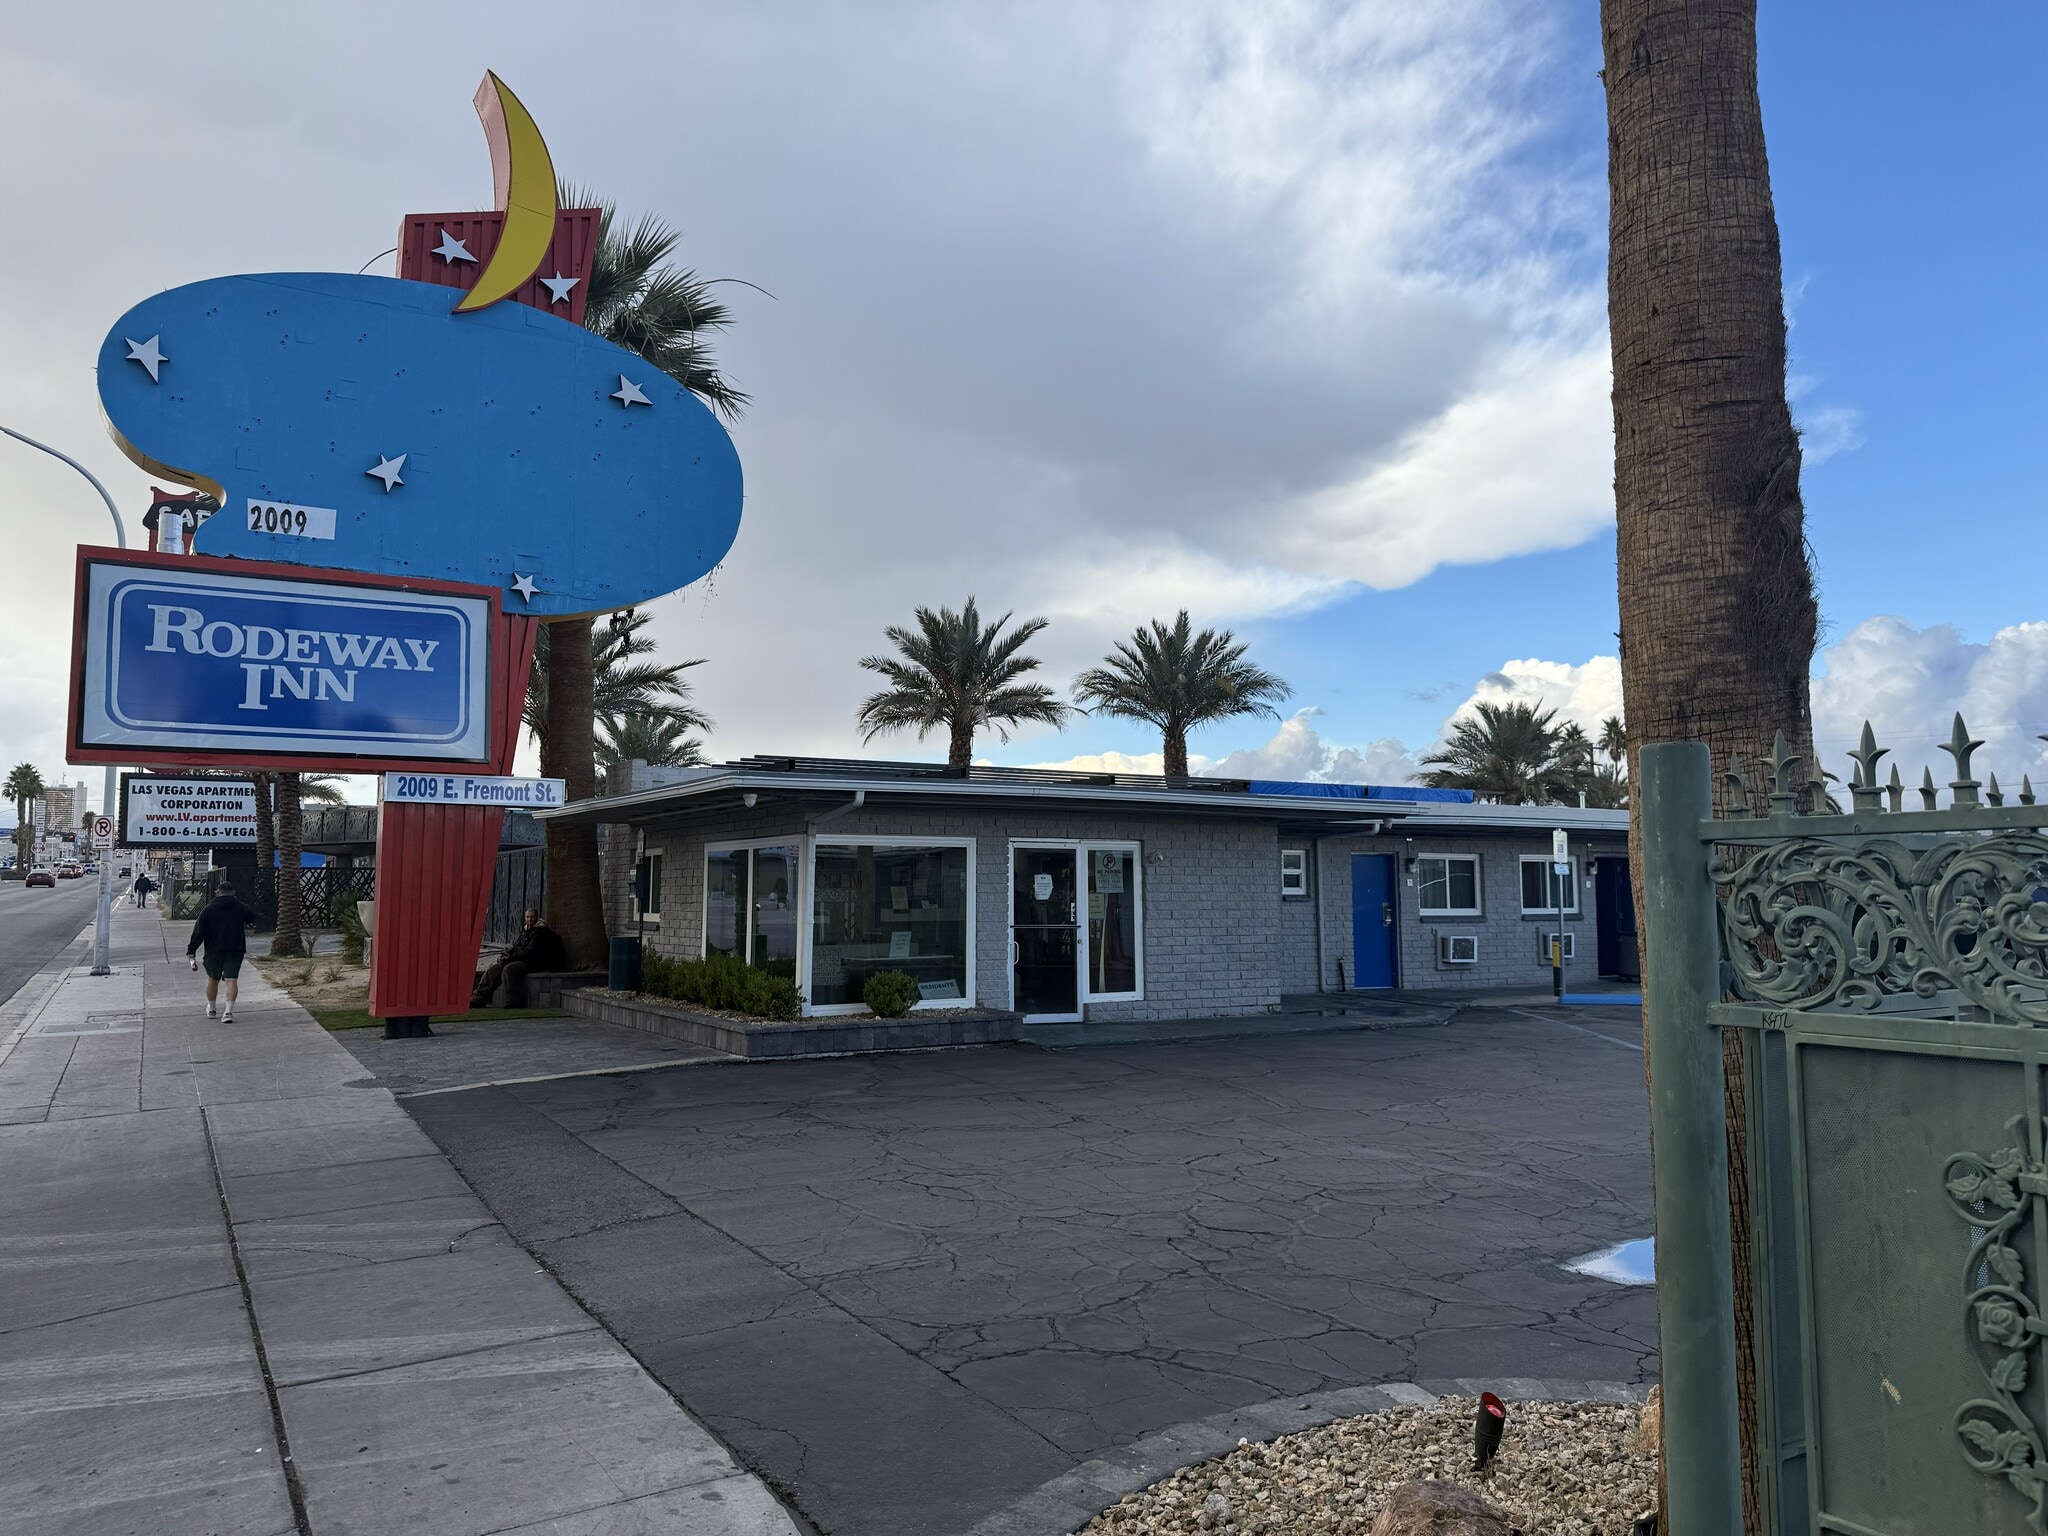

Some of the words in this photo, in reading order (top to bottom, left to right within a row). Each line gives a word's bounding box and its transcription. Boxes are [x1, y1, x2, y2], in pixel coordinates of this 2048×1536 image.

[250, 505, 307, 535] 2009
[145, 603, 439, 672] RODEWAY
[238, 663, 358, 710] INN
[131, 785, 153, 795] LAS
[156, 785, 193, 796] VEGAS
[397, 776, 438, 798] 2009
[443, 778, 459, 798] E.
[464, 779, 530, 801] Fremont
[535, 782, 556, 802] St.
[160, 799, 243, 810] CORPORATION
